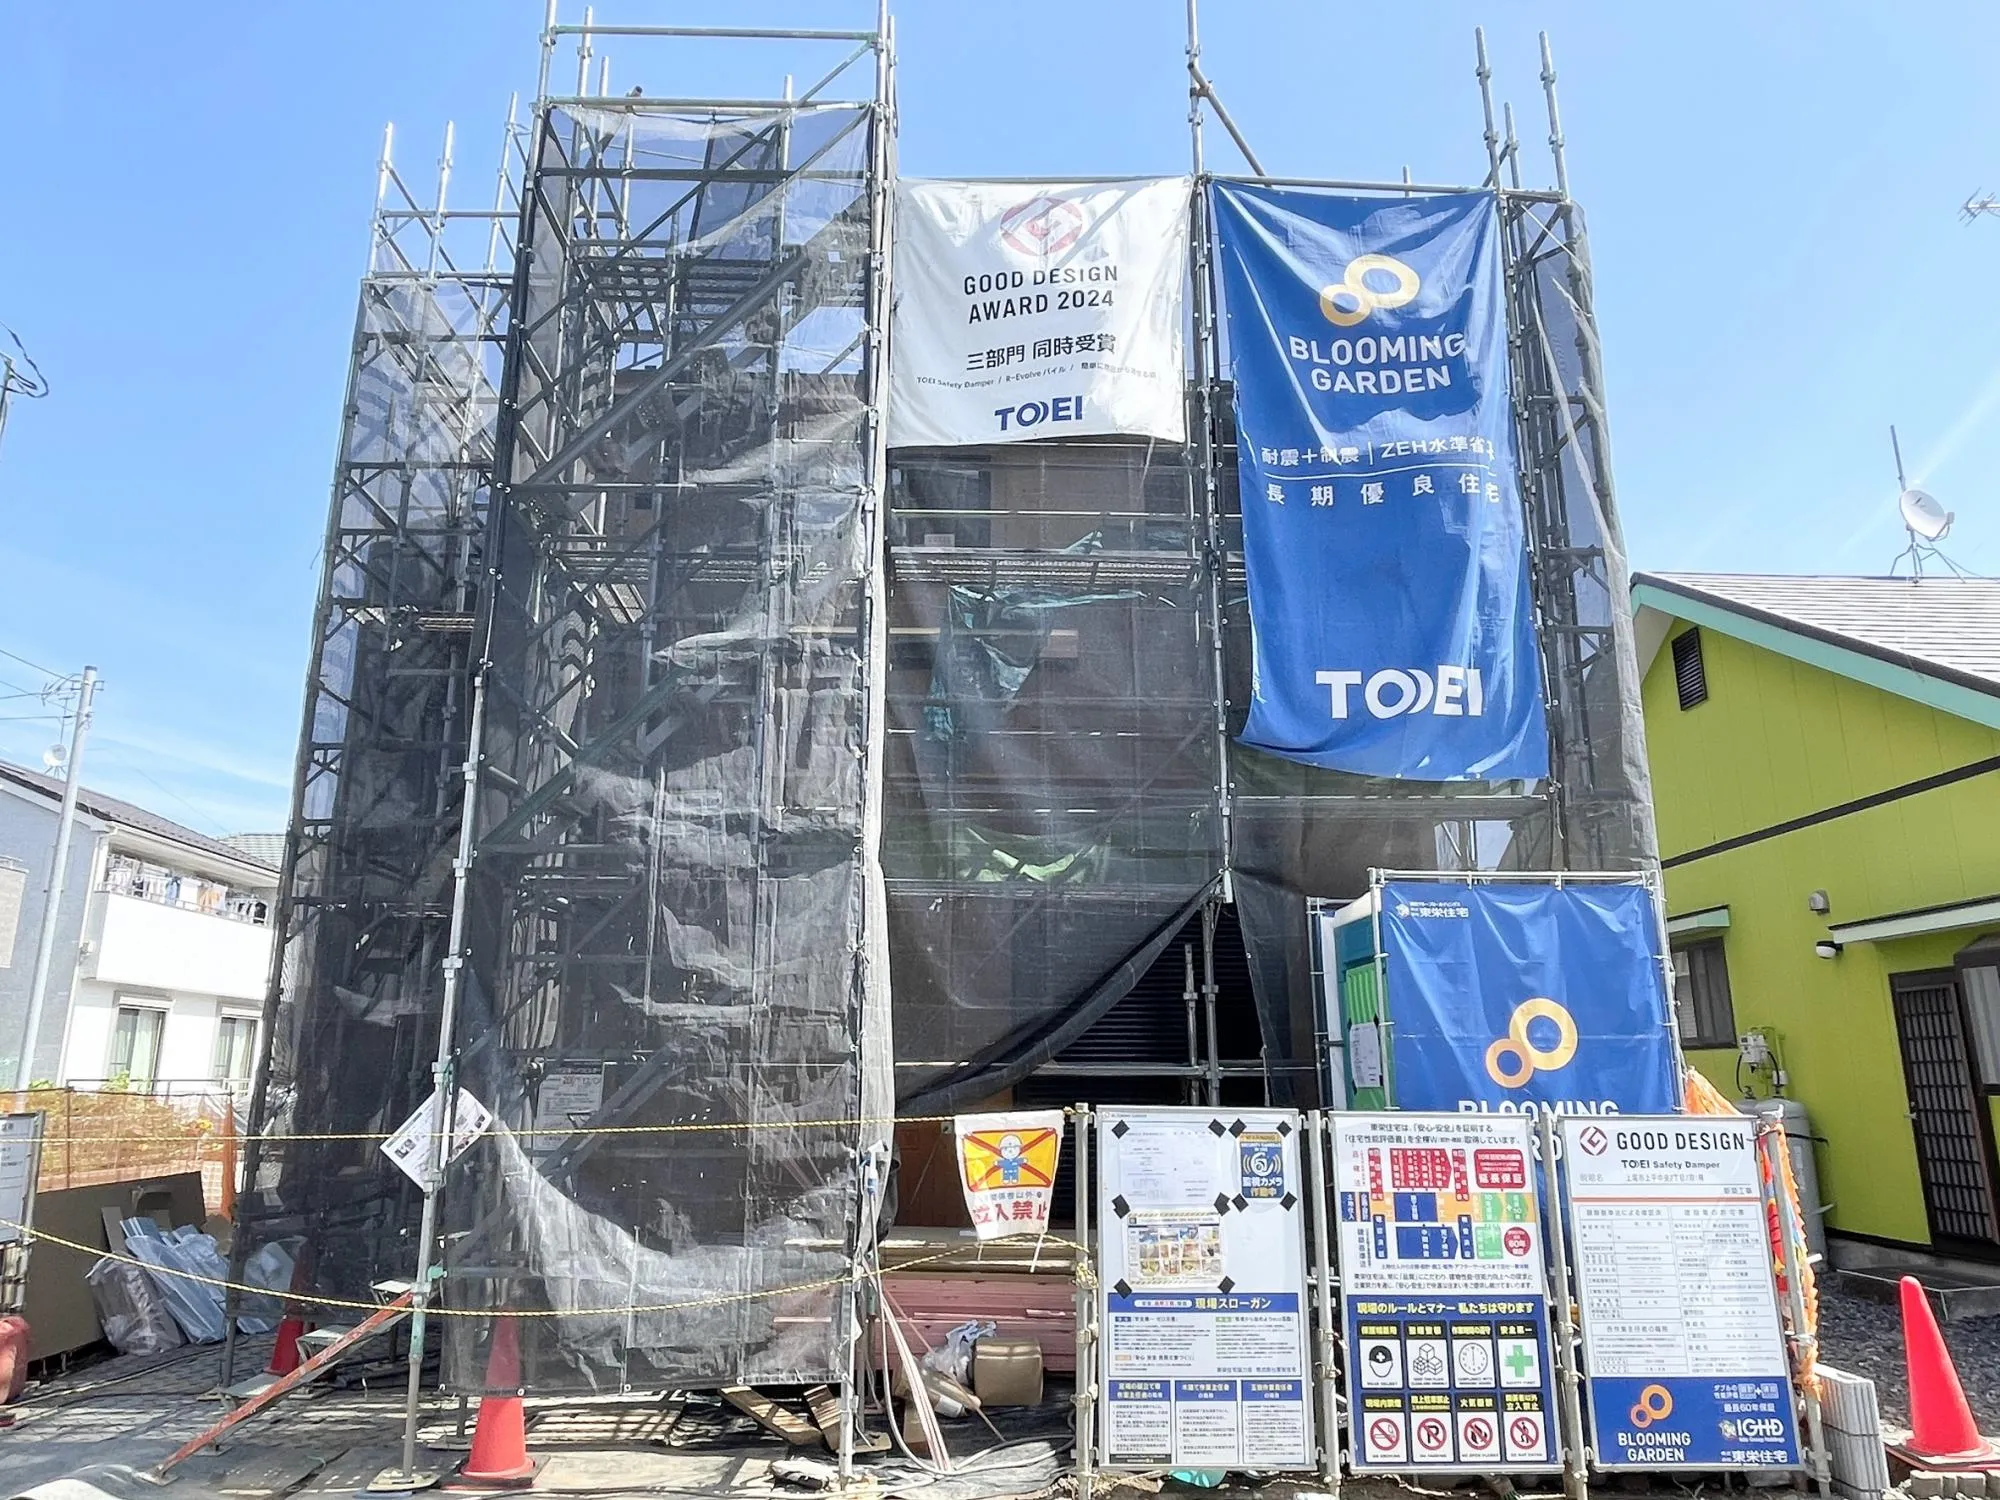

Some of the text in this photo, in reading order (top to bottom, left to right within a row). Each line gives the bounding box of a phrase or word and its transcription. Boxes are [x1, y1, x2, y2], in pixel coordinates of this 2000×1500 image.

[964, 265, 1118, 295] GOOD DESIGN
[968, 290, 1115, 324] AWARD 2024
[966, 333, 1117, 371] 三部門 同時受賞
[1289, 332, 1466, 366] BLOOMING
[964, 378, 994, 388] Damper
[1310, 365, 1451, 395] GARDEN
[994, 395, 1083, 431] TOEI
[1315, 664, 1483, 720] TOEI
[1420, 907, 1469, 918] 東栄住宅
[1616, 1132, 1745, 1150] GOOD DESIGN
[1621, 1160, 1720, 1169] TOEI Safety Damper
[1194, 1297, 1271, 1310] 現場スローガン
[1357, 1302, 1535, 1314] 現場のルールとマナー 私たちは守ります
[1500, 1325, 1533, 1335] 安全第一
[1736, 1418, 1784, 1436] IGHD
[1618, 1432, 1691, 1446] BLOOMING
[1627, 1448, 1685, 1461] GARDEN
[1731, 1450, 1788, 1463] 東栄住宅
